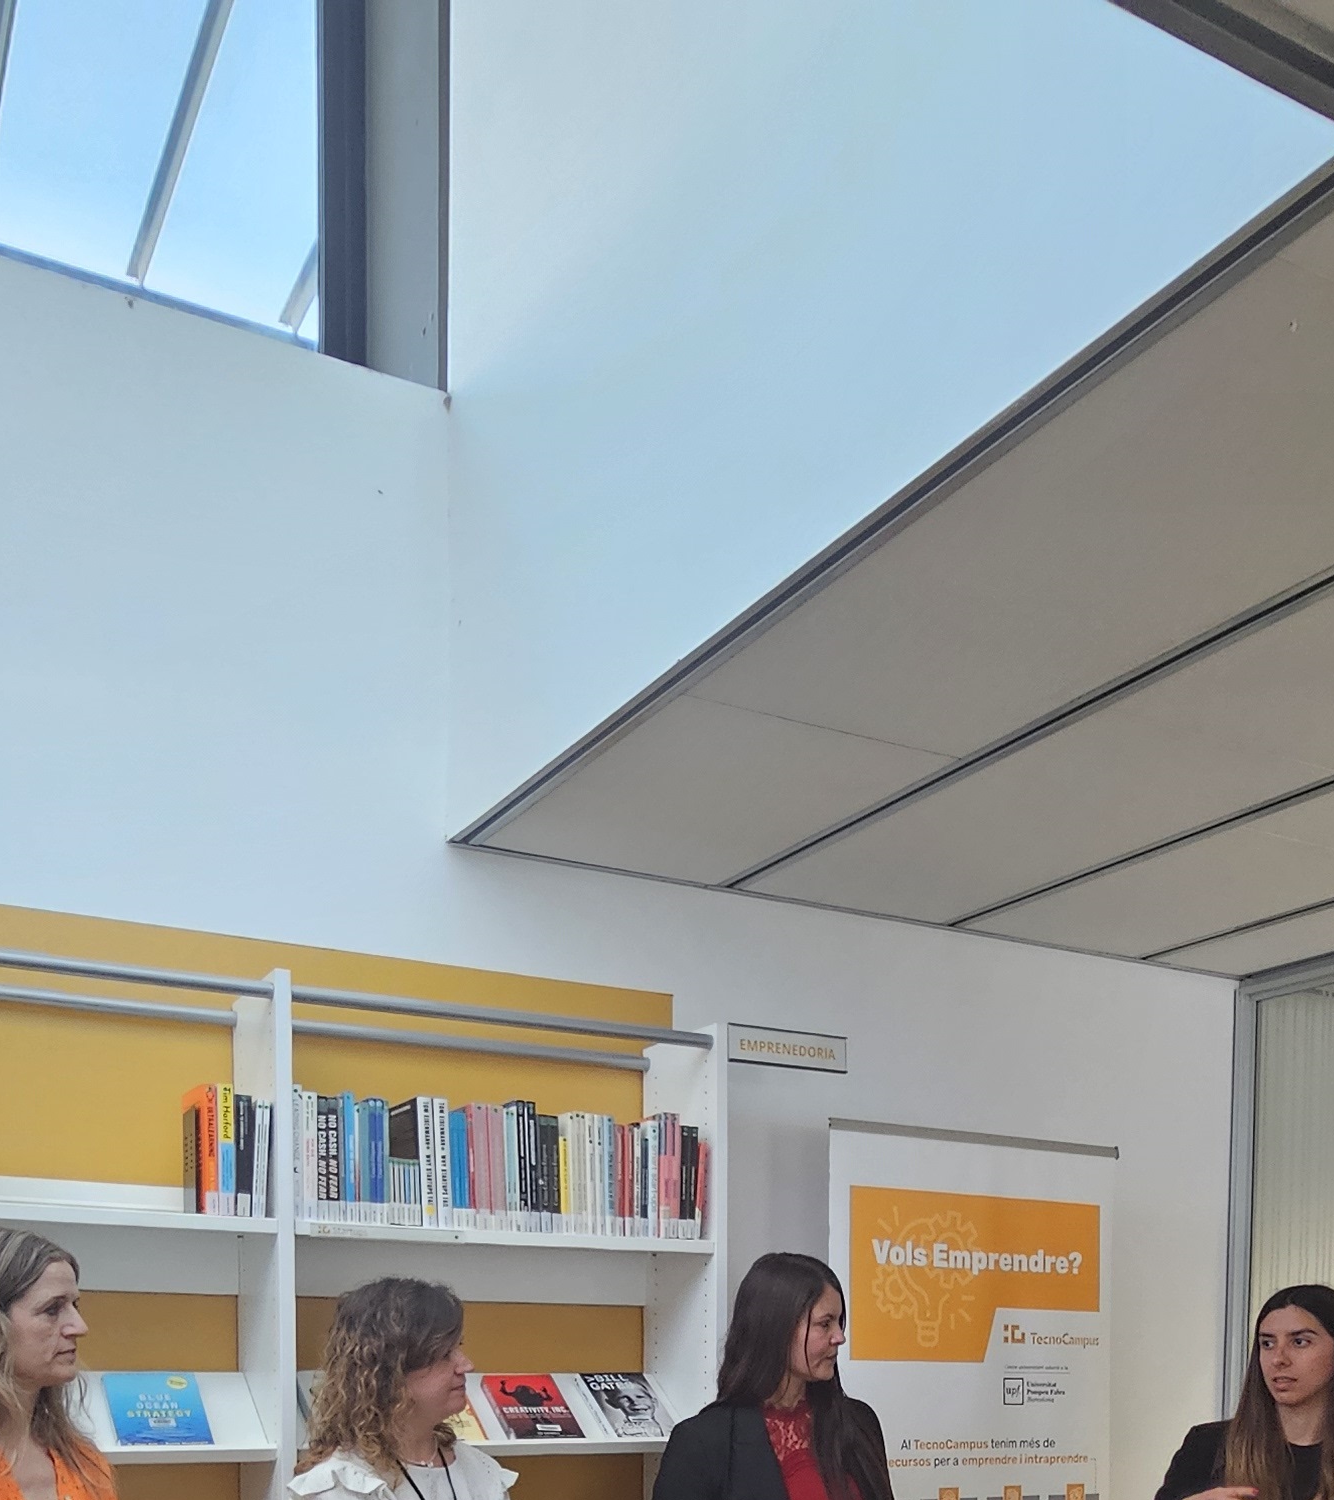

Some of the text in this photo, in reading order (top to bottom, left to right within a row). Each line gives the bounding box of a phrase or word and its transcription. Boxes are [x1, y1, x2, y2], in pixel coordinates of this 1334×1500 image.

[739, 1039, 836, 1060] EMPRENEDORIA
[222, 1087, 232, 1103] Tim
[221, 1104, 232, 1140] Harford
[872, 1238, 1082, 1275] Vols Emprendre?
[1030, 1332, 1099, 1349] TecnoCampus
[597, 1373, 630, 1384] BILL
[126, 1410, 193, 1418] STRATEGY
[136, 1402, 179, 1410] OCEAN
[900, 1437, 1056, 1453] Al TecnoCampus tenim més de
[887, 1457, 931, 1468] ecursos
[933, 1457, 951, 1469] per
[952, 1458, 960, 1467] a
[961, 1455, 1019, 1469] emprendre
[1025, 1453, 1089, 1467] intraprendre
